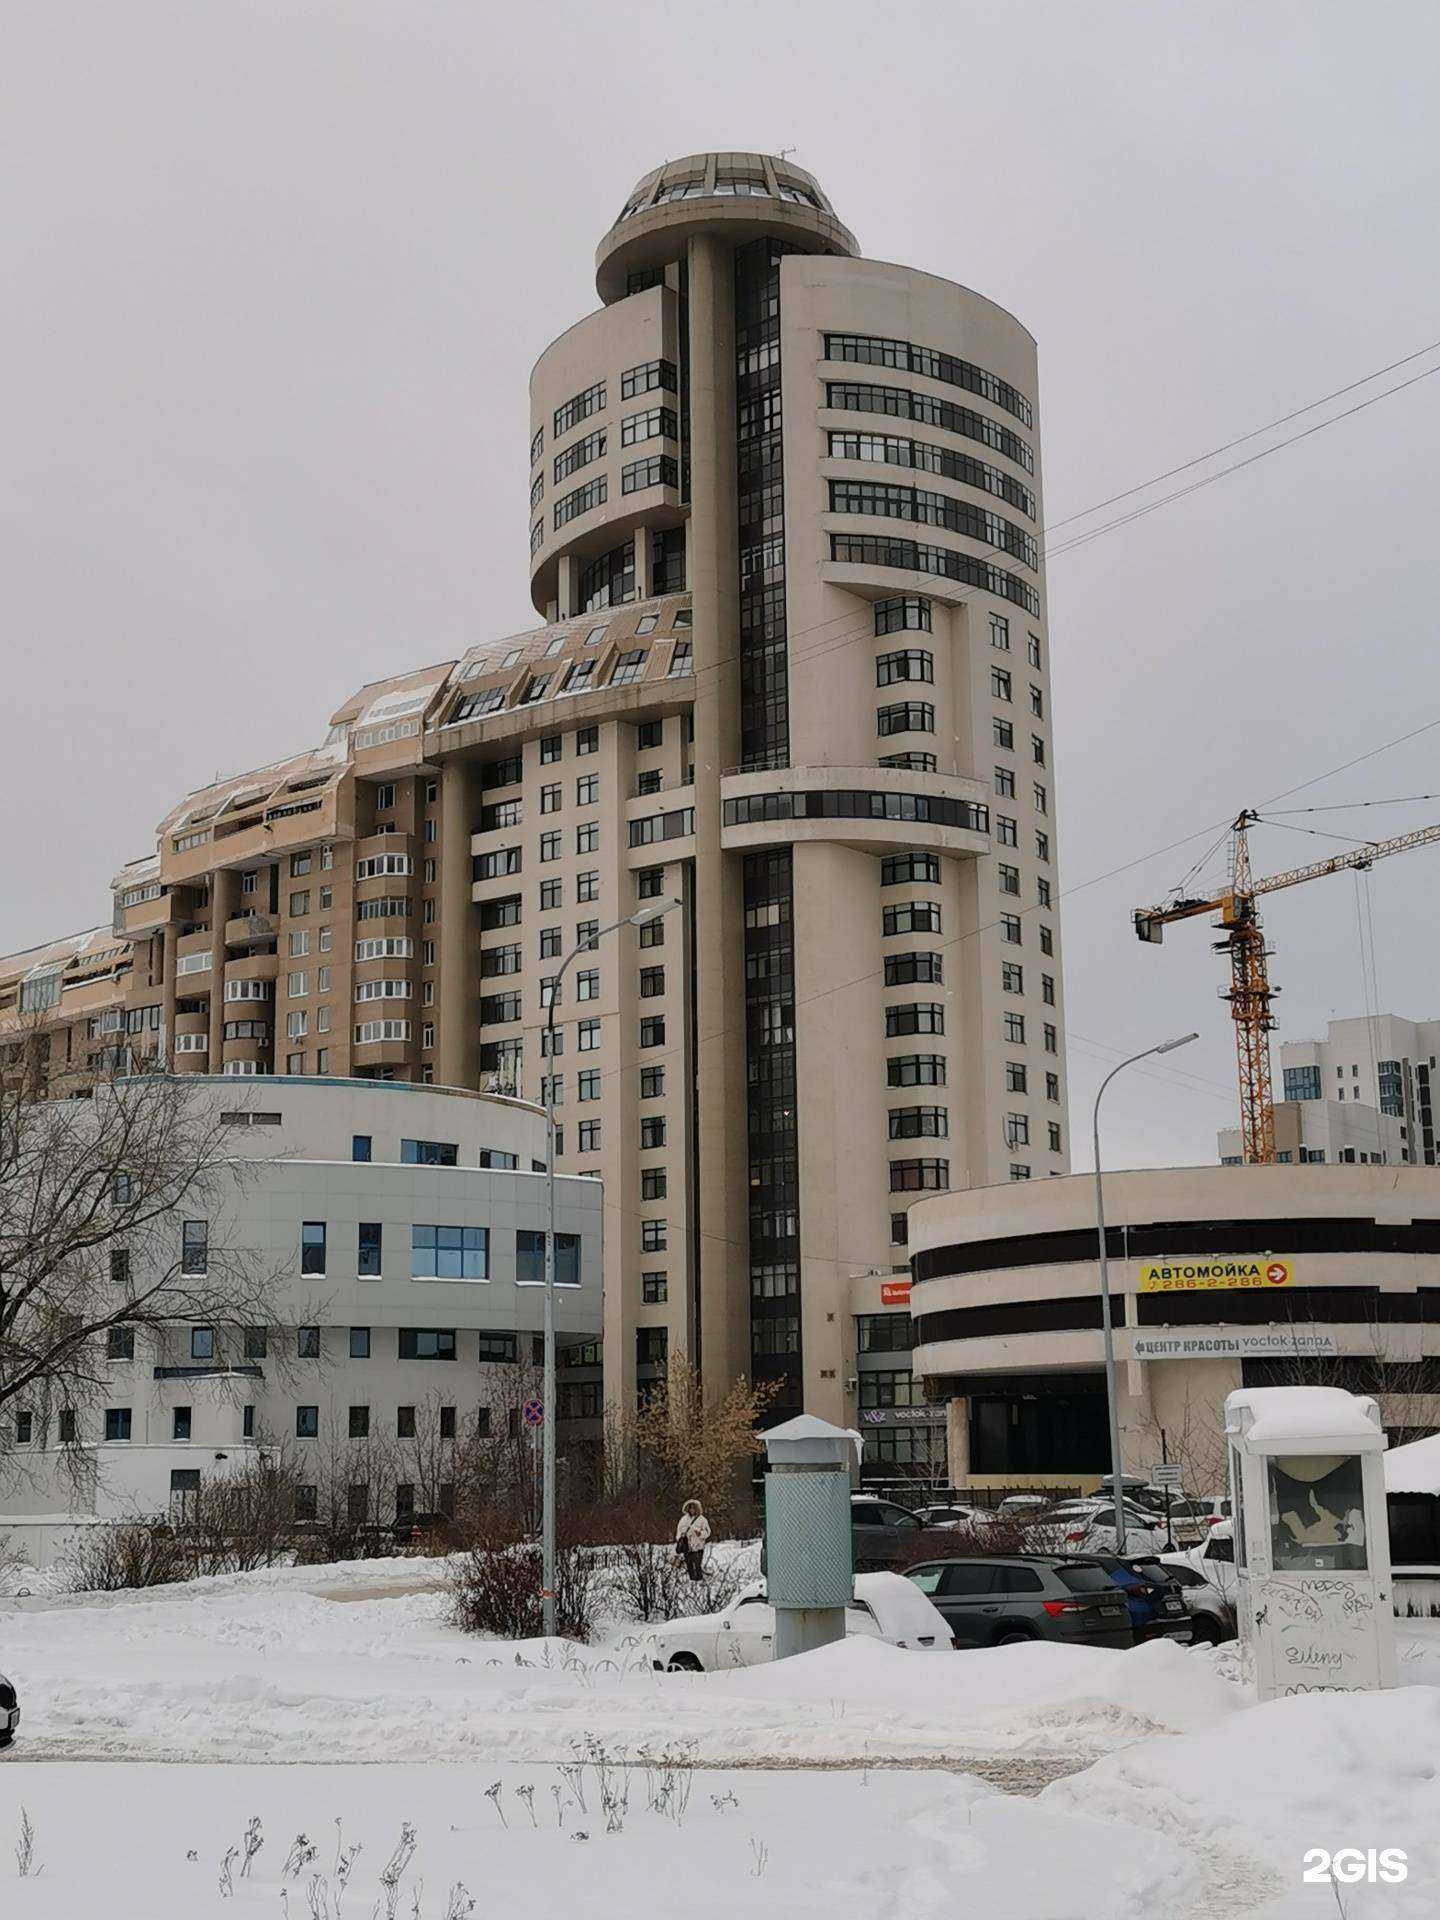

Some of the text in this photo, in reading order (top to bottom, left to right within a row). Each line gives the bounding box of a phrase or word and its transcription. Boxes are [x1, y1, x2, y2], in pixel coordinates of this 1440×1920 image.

[1149, 1263, 1260, 1280] АВТОМОЙКА
[1163, 1277, 1262, 1290] 286-2-286
[1146, 1341, 1181, 1353] ЦЕНТР
[1183, 1339, 1240, 1352] КРАСОТЫ
